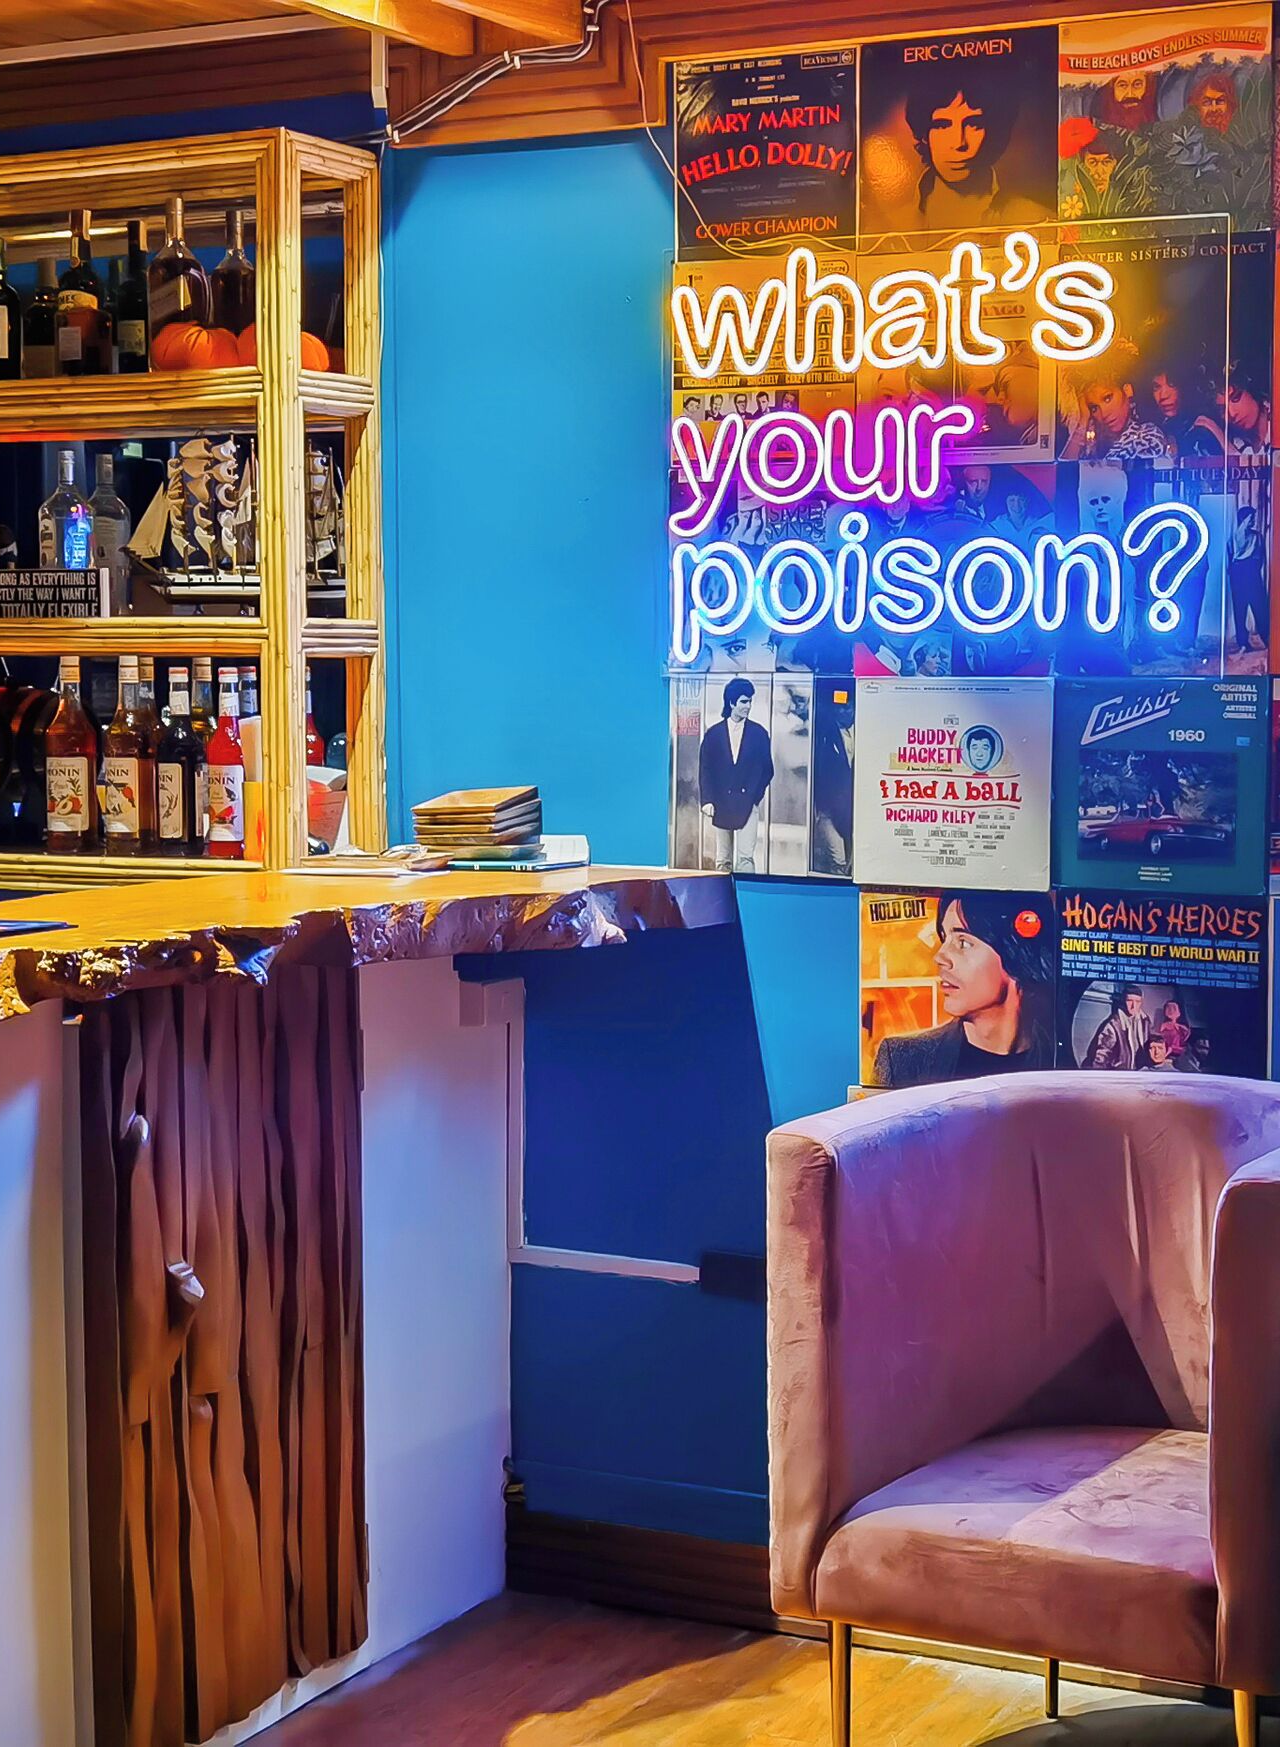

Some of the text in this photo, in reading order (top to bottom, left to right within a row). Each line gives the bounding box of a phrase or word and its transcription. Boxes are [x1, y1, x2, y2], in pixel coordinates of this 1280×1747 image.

[903, 37, 1012, 64] ERIC CARMEN
[1069, 29, 1262, 69] THE BEACH BOYS ENDLESS SUMMER
[693, 104, 840, 136] MARY MARTIN
[681, 141, 853, 186] HELLO, DOLLY!
[696, 216, 838, 239] GOWER CHAMPION
[1131, 246, 1187, 261] SISTERS
[1200, 242, 1267, 256] CONTACT
[672, 231, 1114, 378] what's
[671, 404, 975, 537] your
[20, 573, 31, 586] AS
[32, 572, 85, 586] EVERYTHING
[87, 572, 97, 586] IS
[671, 501, 1210, 663] poison?
[18, 587, 34, 601] THE
[35, 587, 54, 601] WAY
[61, 587, 86, 601] WANT
[0, 603, 46, 618] TOTALLY
[47, 603, 99, 618] FLEXIBLE
[1213, 684, 1257, 693] ORIGINAL
[1220, 693, 1257, 702] ARTISTS
[907, 728, 957, 745] BUDDY
[1168, 730, 1205, 742] 1960
[898, 747, 963, 764] HACKETT
[895, 780, 939, 799] had
[942, 782, 960, 800] A
[886, 808, 938, 823] RICHARD
[942, 809, 976, 824] KILEY
[870, 901, 902, 922] HOLD
[1062, 894, 1262, 939] HOGAN'S HEROES
[1061, 938, 1090, 953] SING
[1092, 940, 1115, 954] THE
[1118, 942, 1148, 956] BEST
[1151, 943, 1168, 957] OF
[1169, 945, 1214, 961] WORLD
[1216, 948, 1246, 963] WAR
[1247, 950, 1260, 964] II
